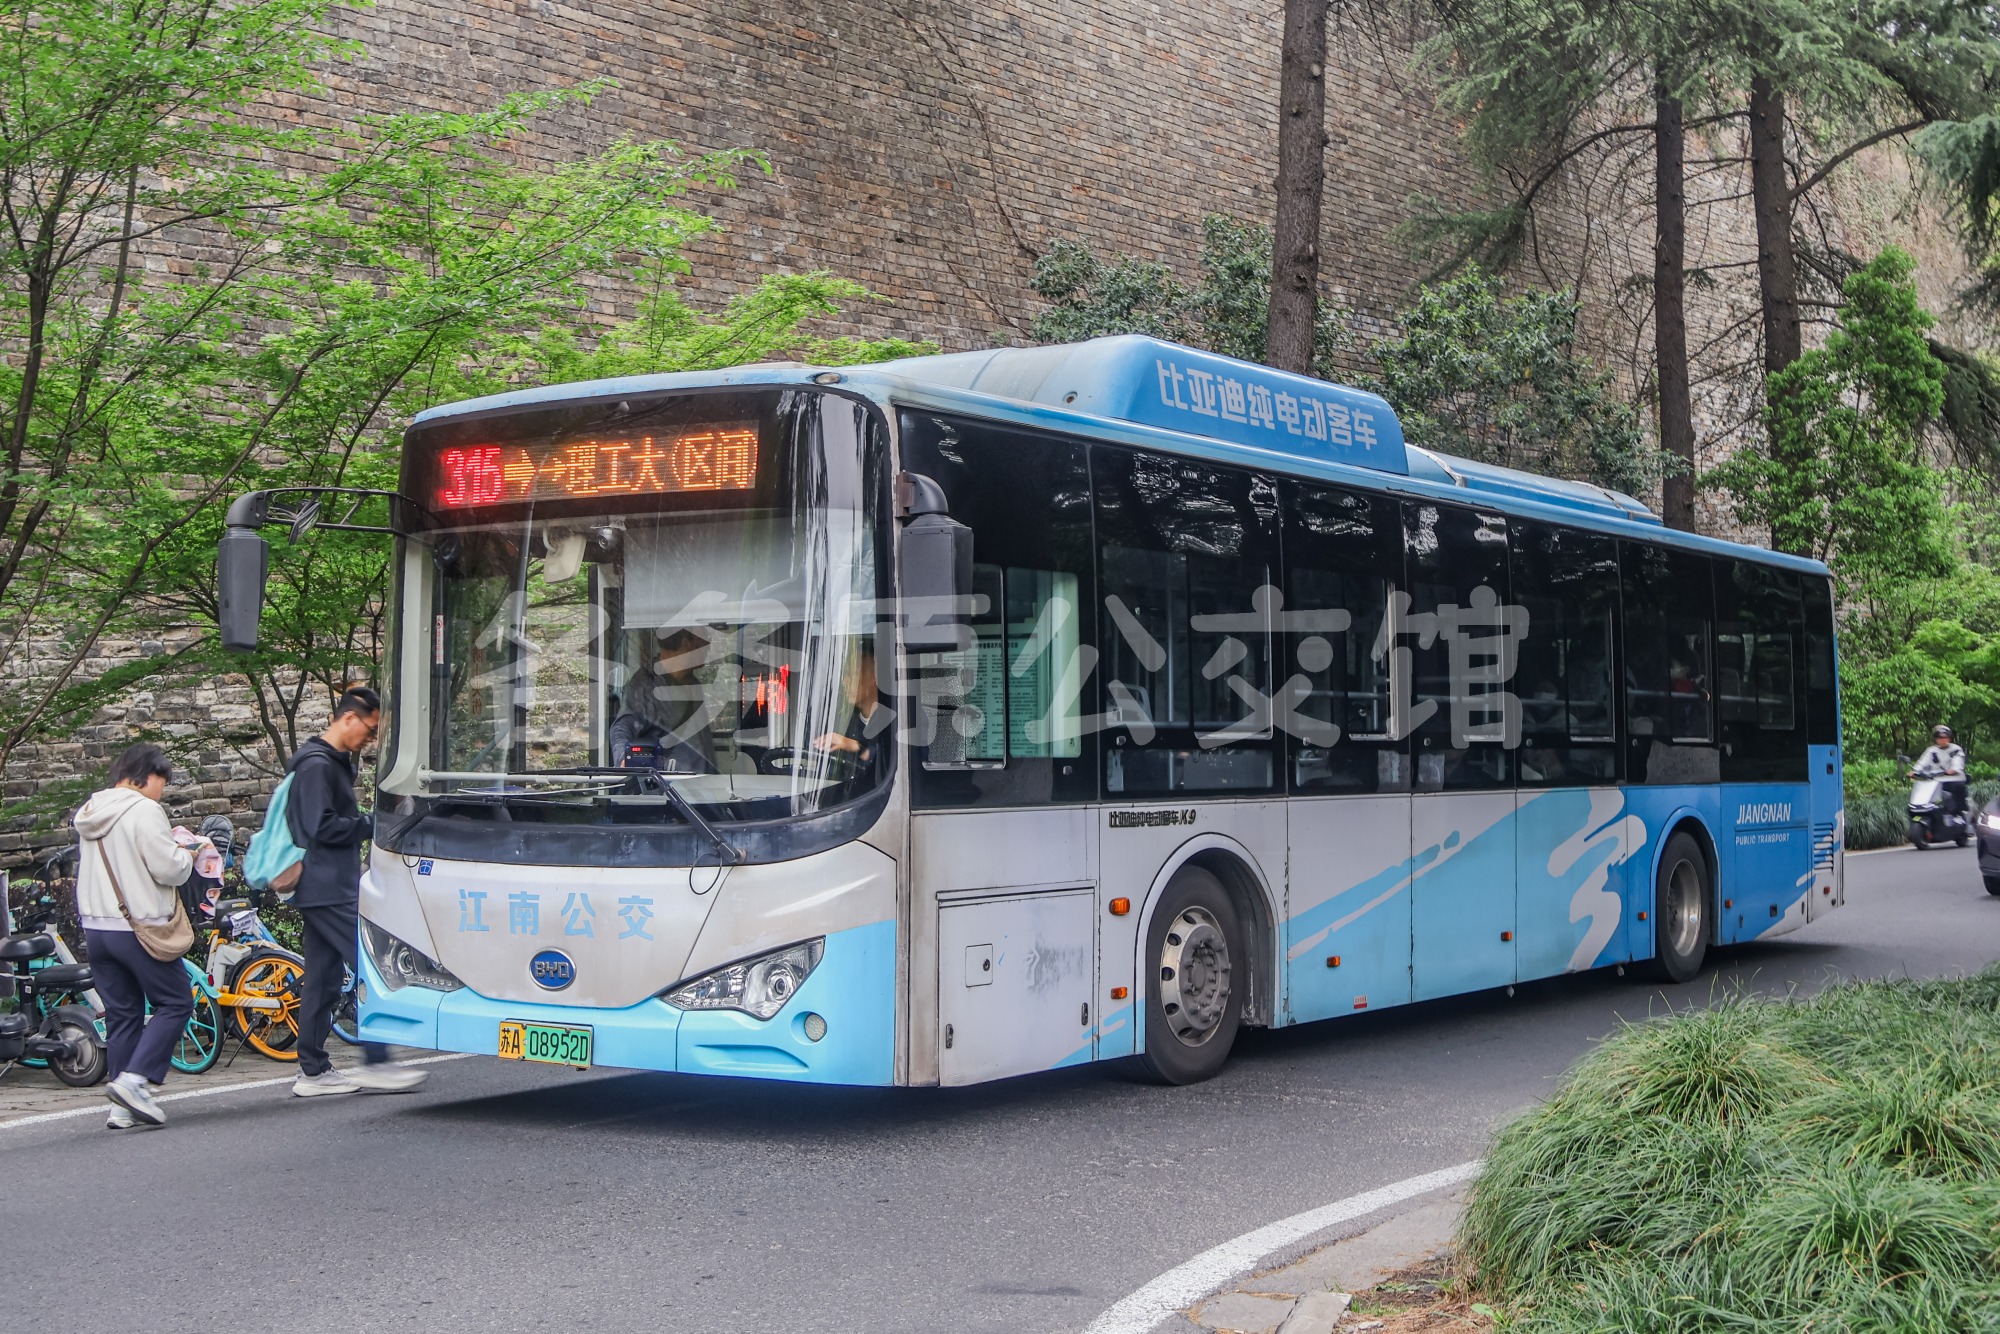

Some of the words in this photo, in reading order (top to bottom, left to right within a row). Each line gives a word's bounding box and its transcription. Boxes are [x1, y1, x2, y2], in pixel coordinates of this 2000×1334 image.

[1156, 359, 1378, 450] 比亚迪纯电动客车
[444, 447, 502, 505] 315
[1736, 803, 1791, 825] JIANGNAN
[1736, 835, 1756, 846] PUBLIC
[1758, 833, 1790, 844] TRANSPORT
[458, 888, 655, 942] 江南公交
[534, 961, 570, 979] BYD
[529, 1030, 589, 1062] 08952D
